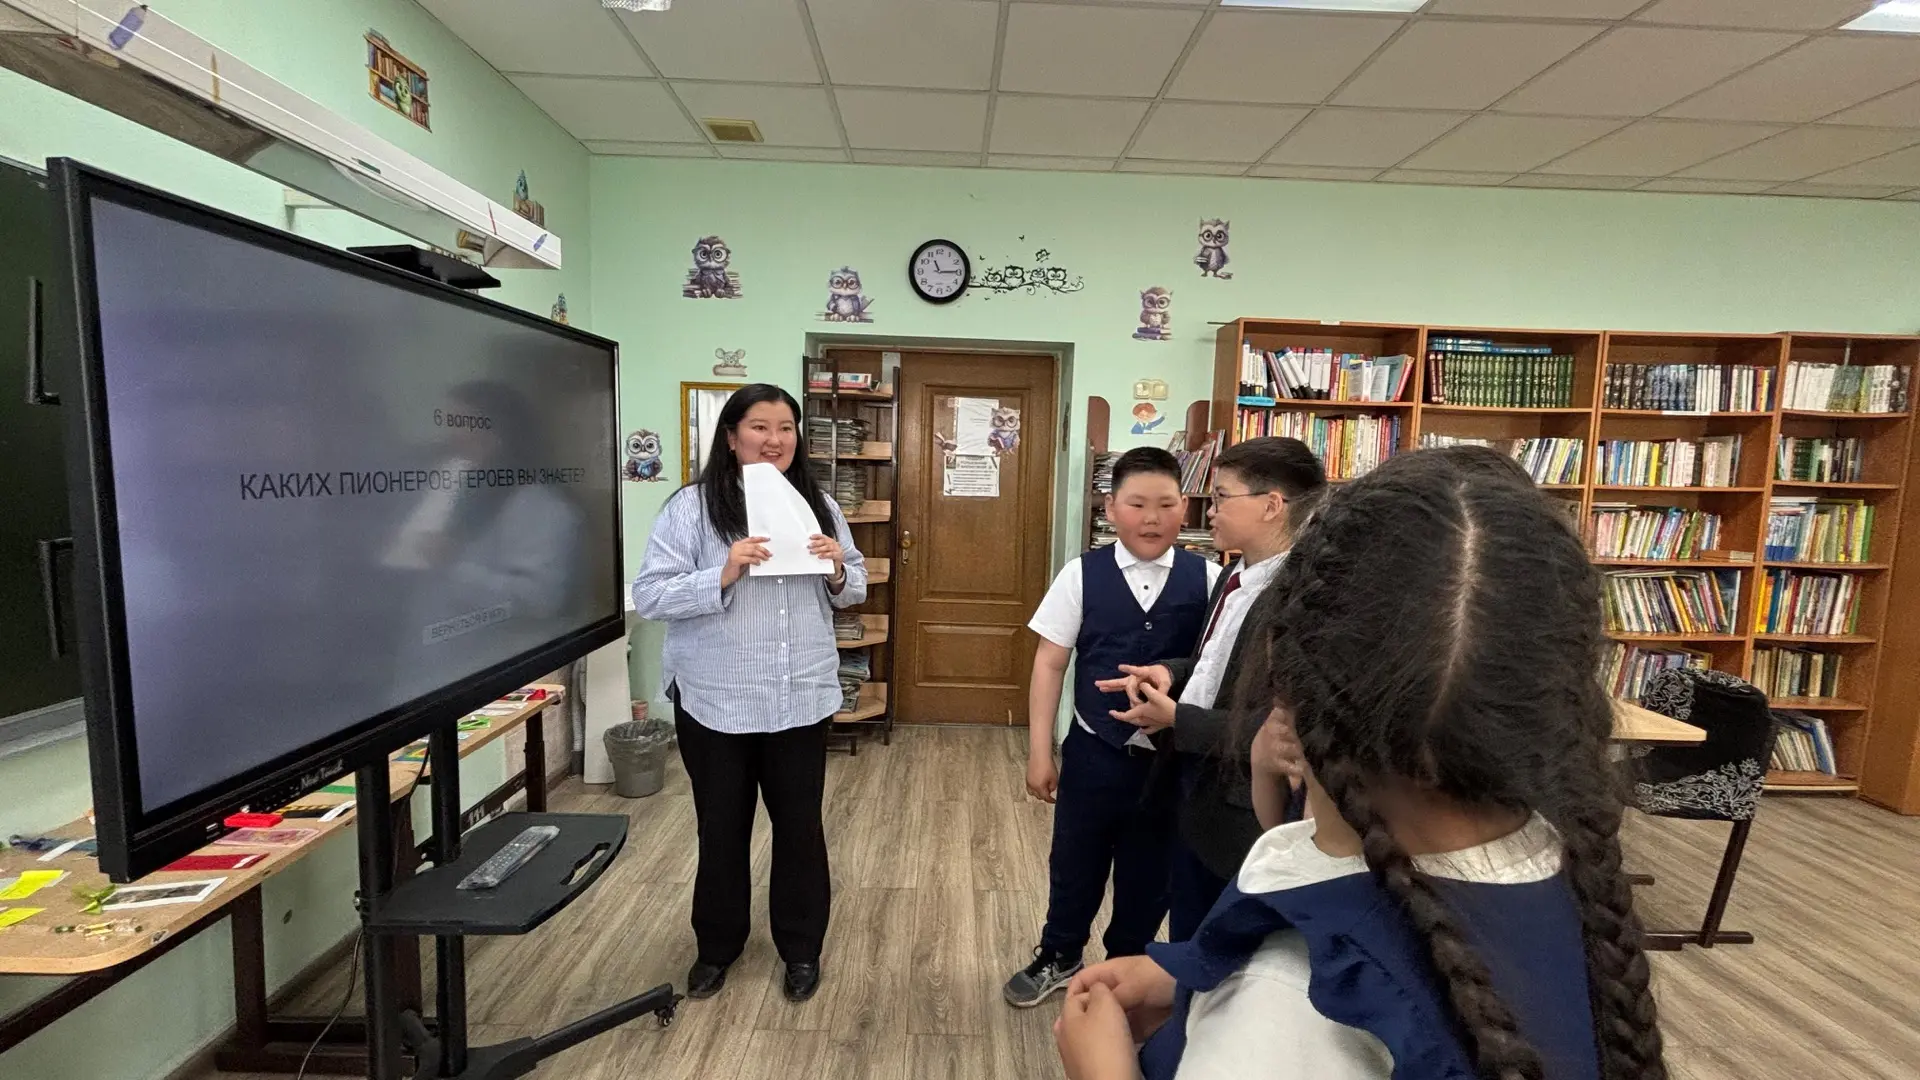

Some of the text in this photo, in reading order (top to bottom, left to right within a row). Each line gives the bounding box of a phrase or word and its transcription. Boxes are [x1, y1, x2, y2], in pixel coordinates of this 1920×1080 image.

[917, 268, 924, 276] 9
[956, 268, 962, 276] 3
[936, 287, 943, 295] 6
[433, 408, 492, 432] 6 вопрос
[240, 468, 585, 500] КАКИХ ПИОНЕРОВ-ГЕРОЕВ ВЫ ЗНАЕТЕ?
